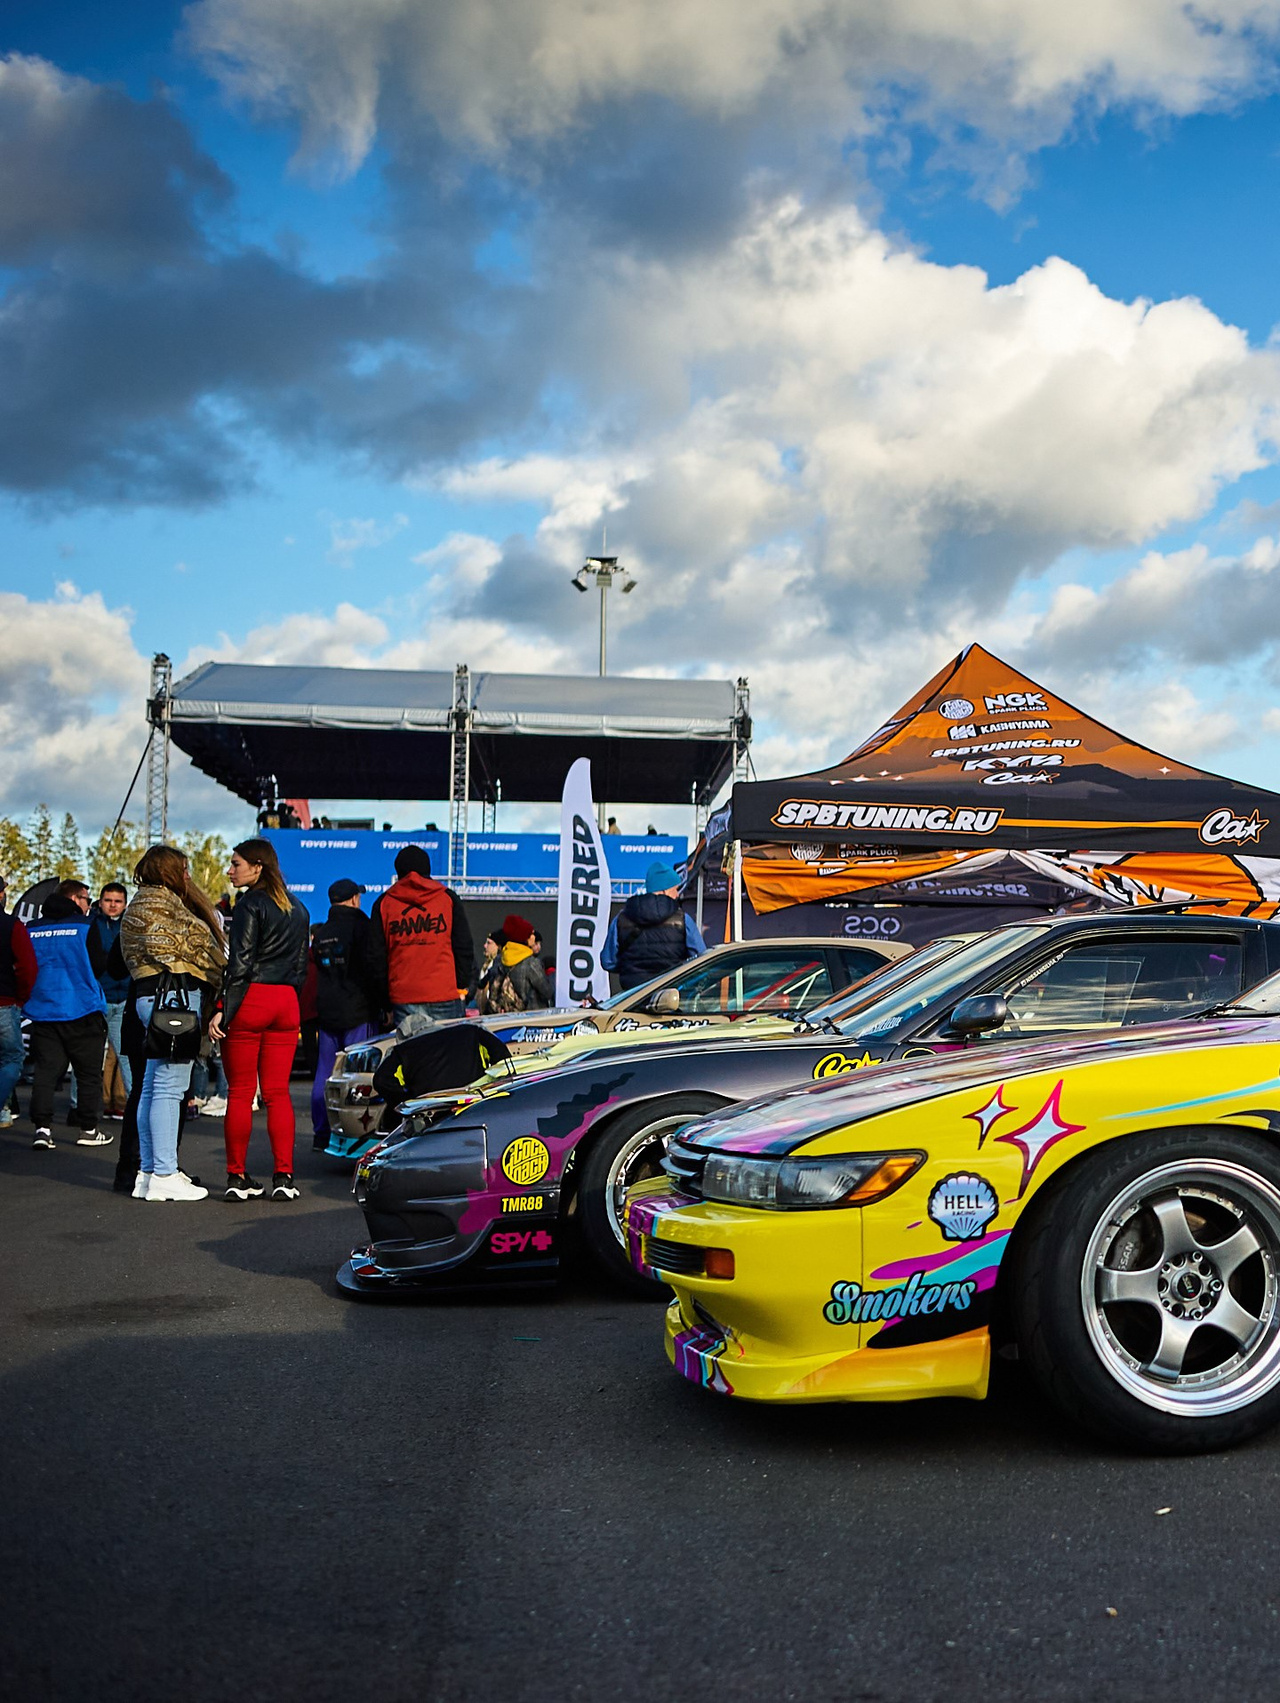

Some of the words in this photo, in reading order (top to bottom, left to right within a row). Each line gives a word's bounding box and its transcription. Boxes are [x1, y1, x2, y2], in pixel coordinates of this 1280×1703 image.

[984, 693, 1047, 709] NGK
[980, 720, 1050, 734] KASHIYAMA
[931, 739, 1081, 758] SPBTUNING.RU
[963, 754, 1063, 771] KYB
[776, 802, 999, 832] SPBTUNING.RU
[300, 840, 326, 848] TOYO
[328, 840, 357, 849] TIRES
[468, 843, 489, 851] OYO
[490, 843, 518, 851] TIRES
[542, 844, 560, 852] TOY
[620, 845, 645, 853] TOYO
[646, 845, 674, 853] TIRES
[840, 849, 868, 858] SPARK
[869, 848, 899, 856] PLUGS
[569, 813, 600, 1002] CODERED
[389, 913, 447, 937] BANNED
[30, 930, 52, 939] TOYO
[52, 929, 78, 937] TIRES
[525, 1033, 565, 1043] WHEELS
[502, 1196, 544, 1212] TMR88
[944, 1194, 984, 1211] HELL
[825, 1272, 976, 1324] Smokers
